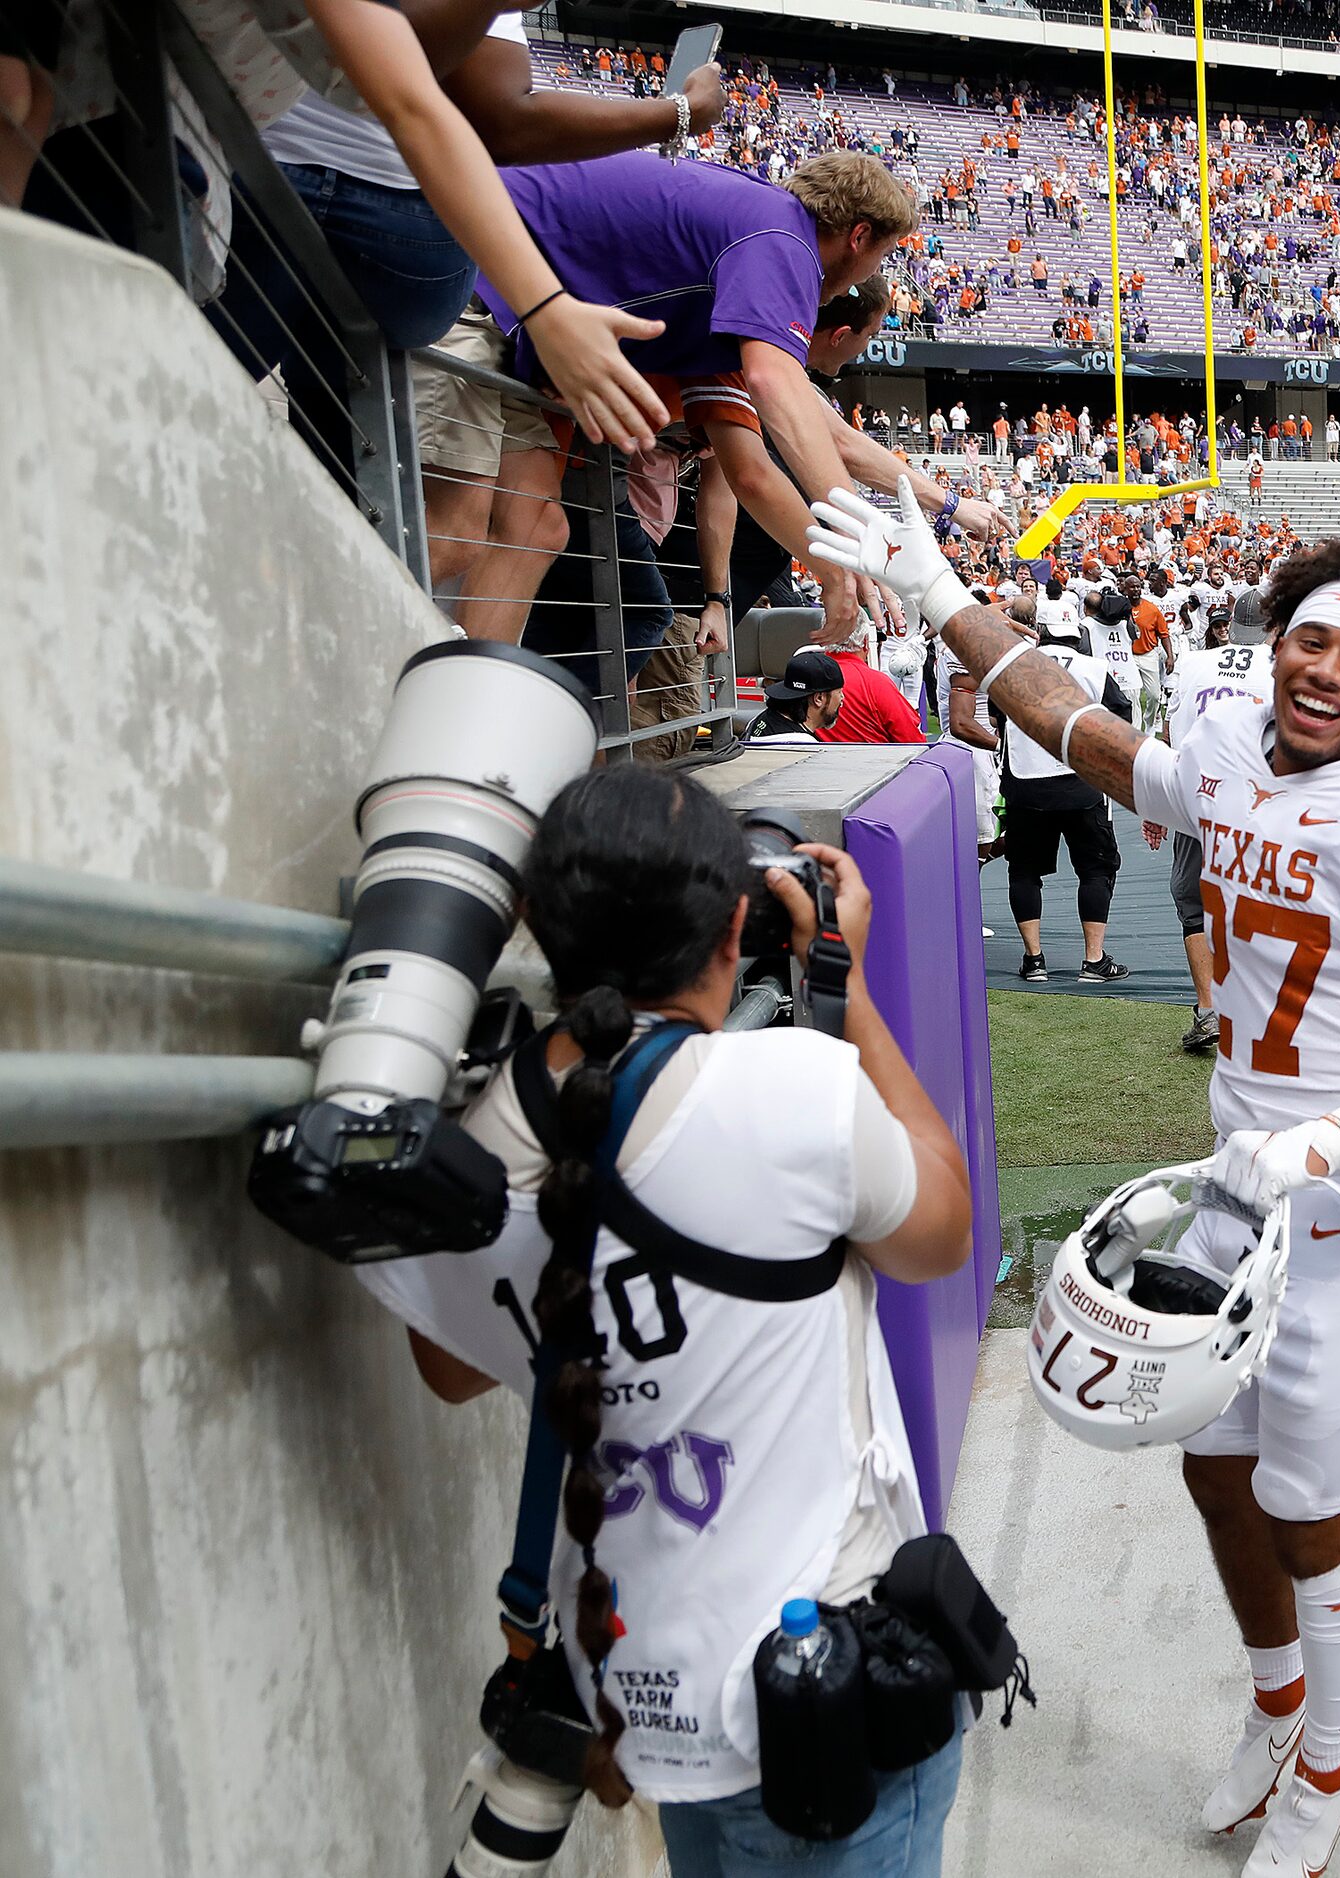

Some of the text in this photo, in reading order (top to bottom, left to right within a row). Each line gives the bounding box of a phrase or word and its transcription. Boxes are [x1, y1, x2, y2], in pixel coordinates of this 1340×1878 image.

[1284, 360, 1329, 383] TCU
[1108, 632, 1121, 643] 41
[1105, 651, 1128, 662] TCU
[1218, 648, 1254, 671] 33
[1218, 671, 1246, 680] PHOTO
[1197, 774, 1222, 798] XII
[1198, 817, 1318, 903] TEXAS
[492, 1252, 688, 1377] 10
[1060, 1273, 1151, 1340] LONGHORNS
[1042, 1331, 1119, 1410] 27
[1131, 1360, 1167, 1374] UNITY
[601, 1380, 660, 1406] OTO
[599, 1431, 735, 1535] CU
[613, 1670, 679, 1688] TEXAS
[623, 1689, 673, 1710] FARM
[628, 1709, 699, 1734] BUREAU
